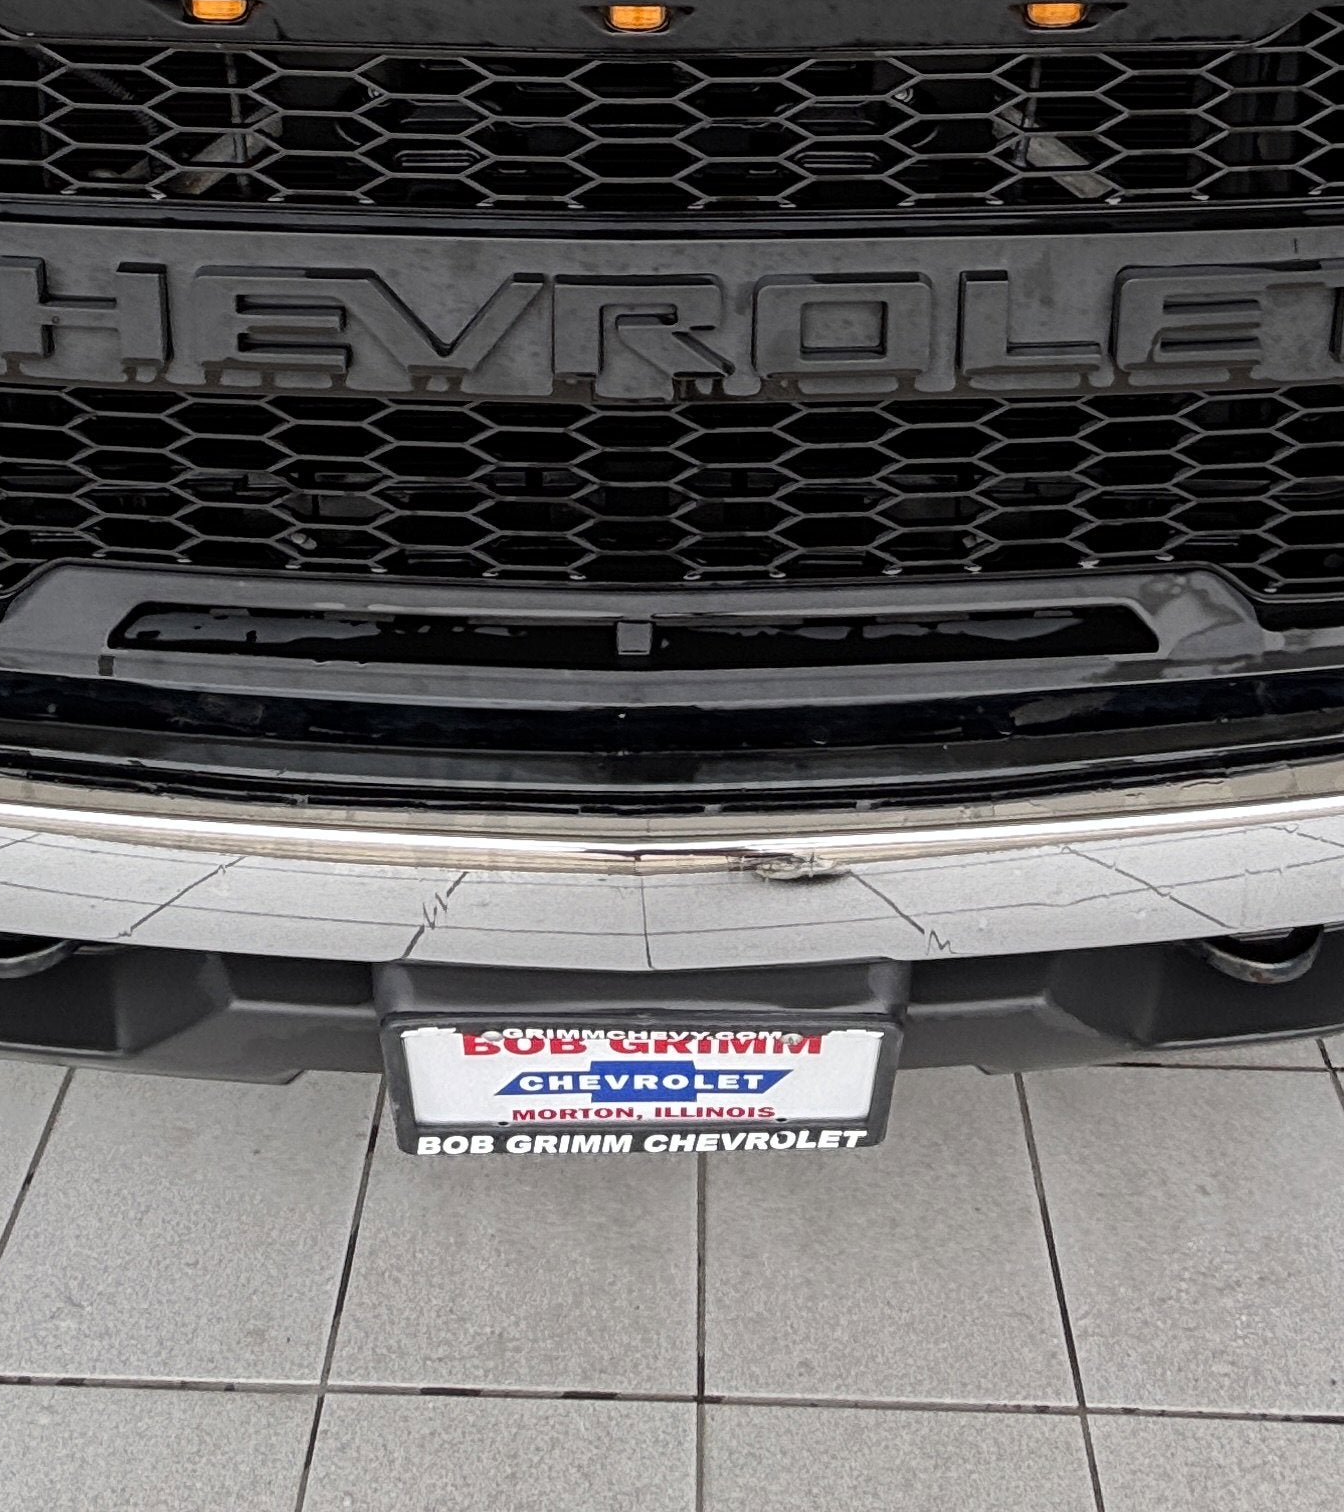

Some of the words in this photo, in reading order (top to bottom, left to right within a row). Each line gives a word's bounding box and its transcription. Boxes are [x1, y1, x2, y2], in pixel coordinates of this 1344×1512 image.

[502, 1028, 783, 1041] GRIMMCHEVY.COM
[519, 1074, 764, 1092] CHEVROLET
[512, 1106, 644, 1122] MORTON,
[654, 1106, 776, 1119] ILLINOIS
[417, 1135, 495, 1156] BOB
[506, 1134, 634, 1155] GRIMM
[643, 1129, 868, 1154] CHEVROLET
